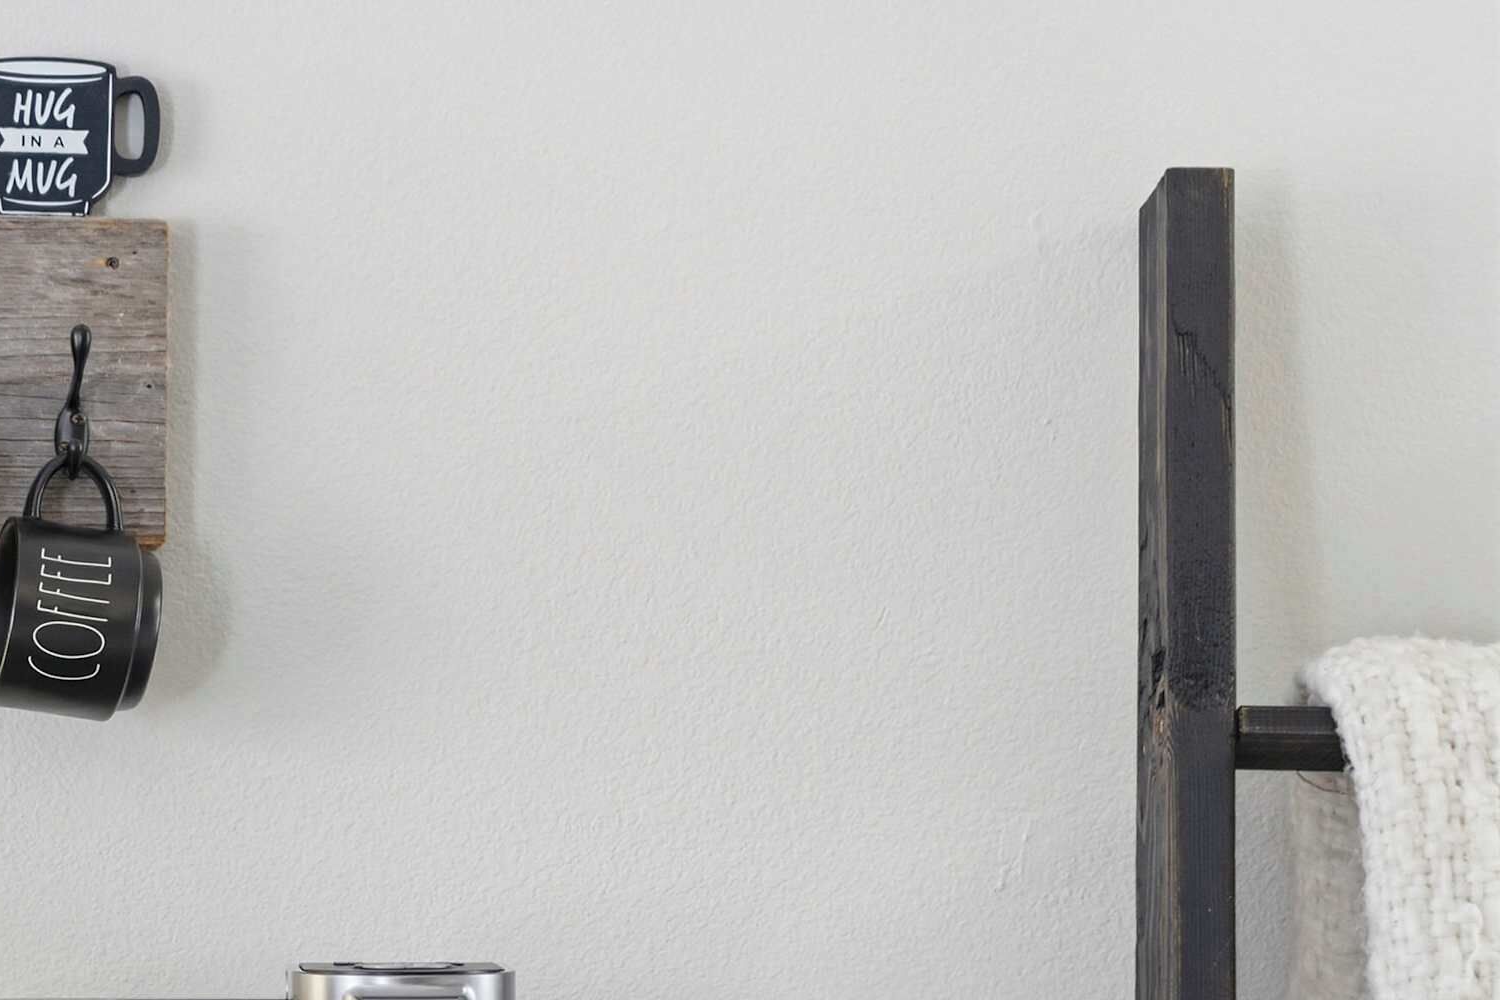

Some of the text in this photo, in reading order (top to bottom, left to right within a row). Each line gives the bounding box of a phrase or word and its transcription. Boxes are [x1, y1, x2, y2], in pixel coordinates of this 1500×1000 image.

[13, 87, 75, 129] HUG
[21, 135, 65, 148] IN A
[5, 156, 78, 198] MUG
[27, 547, 112, 681] COFFEE
